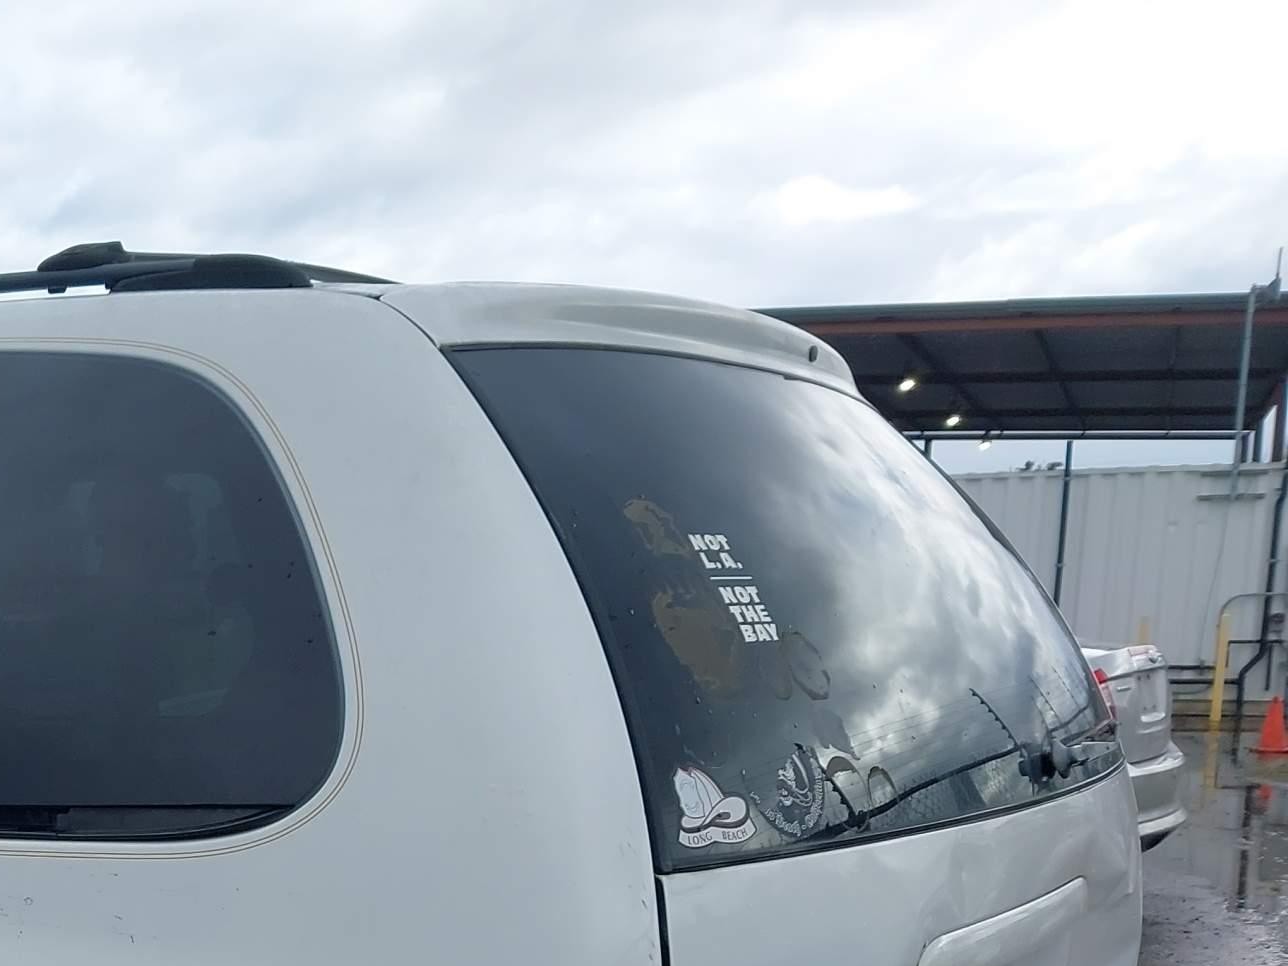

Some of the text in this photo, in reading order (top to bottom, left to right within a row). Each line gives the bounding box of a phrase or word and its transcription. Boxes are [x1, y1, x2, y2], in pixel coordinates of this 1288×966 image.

[688, 533, 730, 551] NOT
[699, 552, 743, 569] L.A.
[718, 586, 761, 604] NOT
[728, 604, 772, 622] THE
[739, 623, 779, 642] BAY
[687, 828, 748, 845] LONG BEACH
